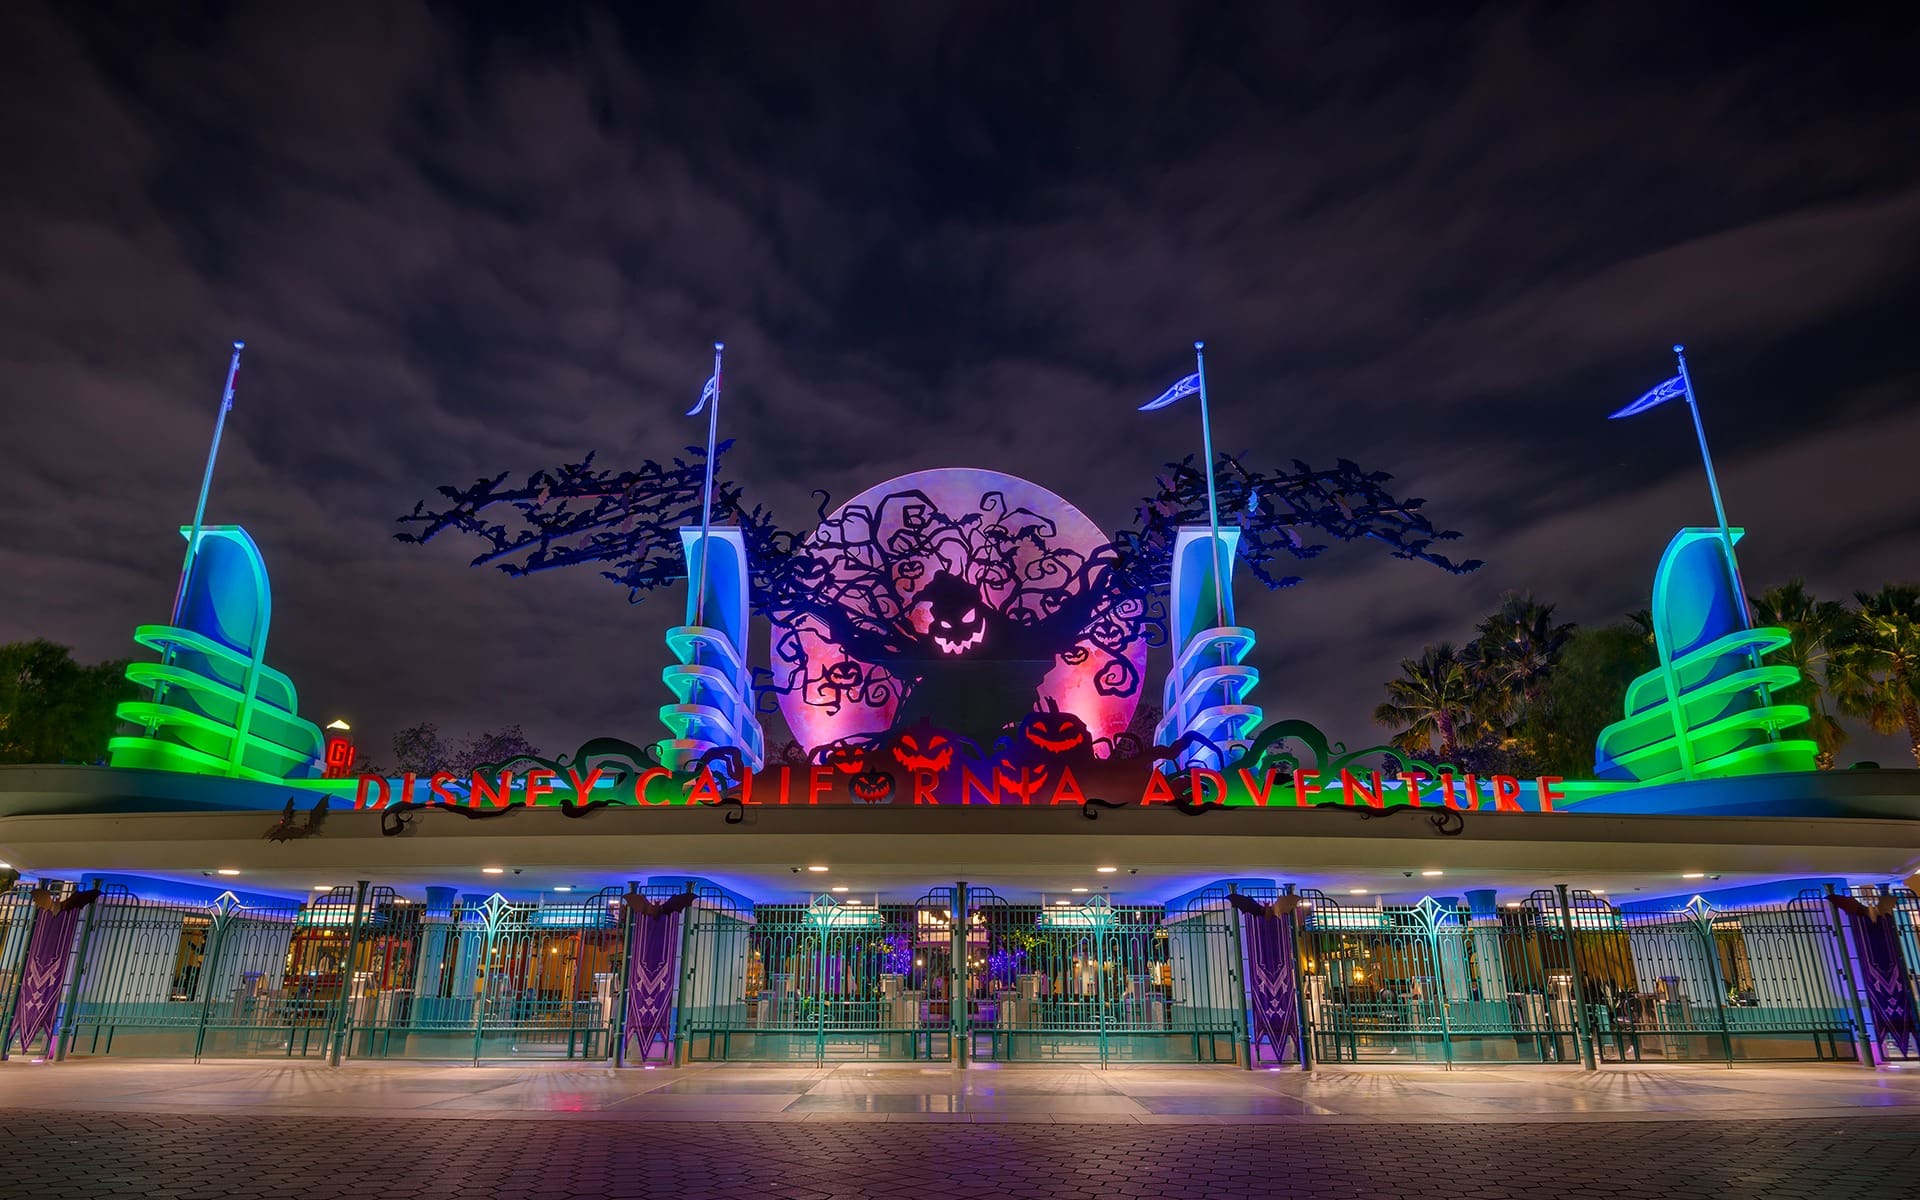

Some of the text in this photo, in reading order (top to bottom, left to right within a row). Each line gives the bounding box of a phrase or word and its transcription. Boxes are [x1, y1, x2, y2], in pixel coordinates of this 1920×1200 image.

[354, 766, 1568, 813] DISNEY CALIFRNIA ADVENTURE
